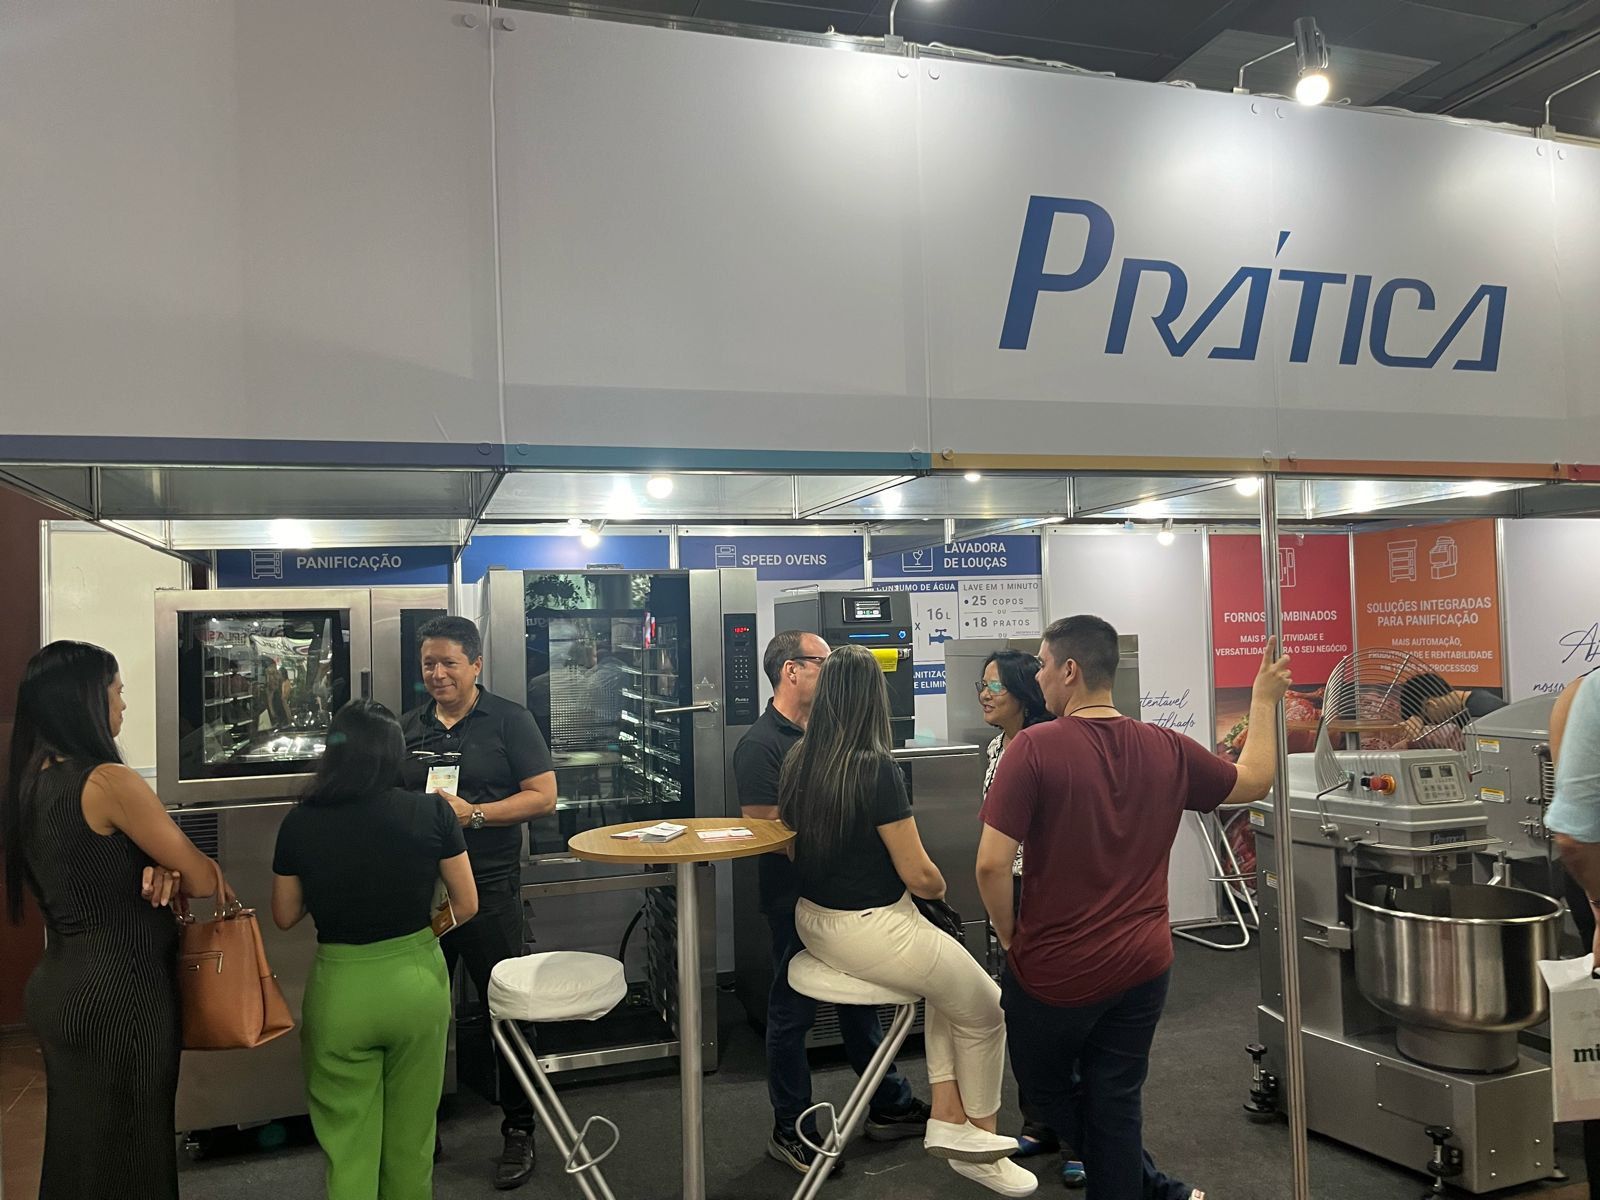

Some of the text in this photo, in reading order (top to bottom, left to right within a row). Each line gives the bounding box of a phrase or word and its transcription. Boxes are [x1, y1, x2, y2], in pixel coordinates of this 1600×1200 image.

[944, 542, 1006, 553] LAVADORA
[296, 553, 402, 571] PANIFICAÇÃO
[742, 554, 827, 566] SPEED OVENS
[943, 556, 1008, 571] DE LOUÇAS
[920, 583, 931, 591] DE
[933, 581, 956, 591] ÁGUA
[963, 583, 983, 592] LAVE
[985, 582, 999, 591] EM
[1008, 582, 1040, 591] MINUTO
[971, 595, 1025, 607] 25 COPOS
[1366, 596, 1492, 615] SOLUÇÕES INTEGRADAS
[926, 607, 944, 621] 16
[1224, 611, 1266, 623] FORNOS
[1377, 610, 1479, 627] PARA PANIFICAÇÃO
[972, 616, 1031, 628] 18 PRATOS
[1240, 634, 1260, 643] MAIS
[1319, 632, 1325, 641] E
[1391, 636, 1463, 648] MAIS AUTOMAÇÃO,
[1294, 645, 1300, 654] O
[1300, 645, 1315, 653] SEU
[1316, 643, 1347, 653] NEGÓCIO
[1424, 650, 1430, 659] E
[1431, 650, 1493, 659] RENTABILIDADE
